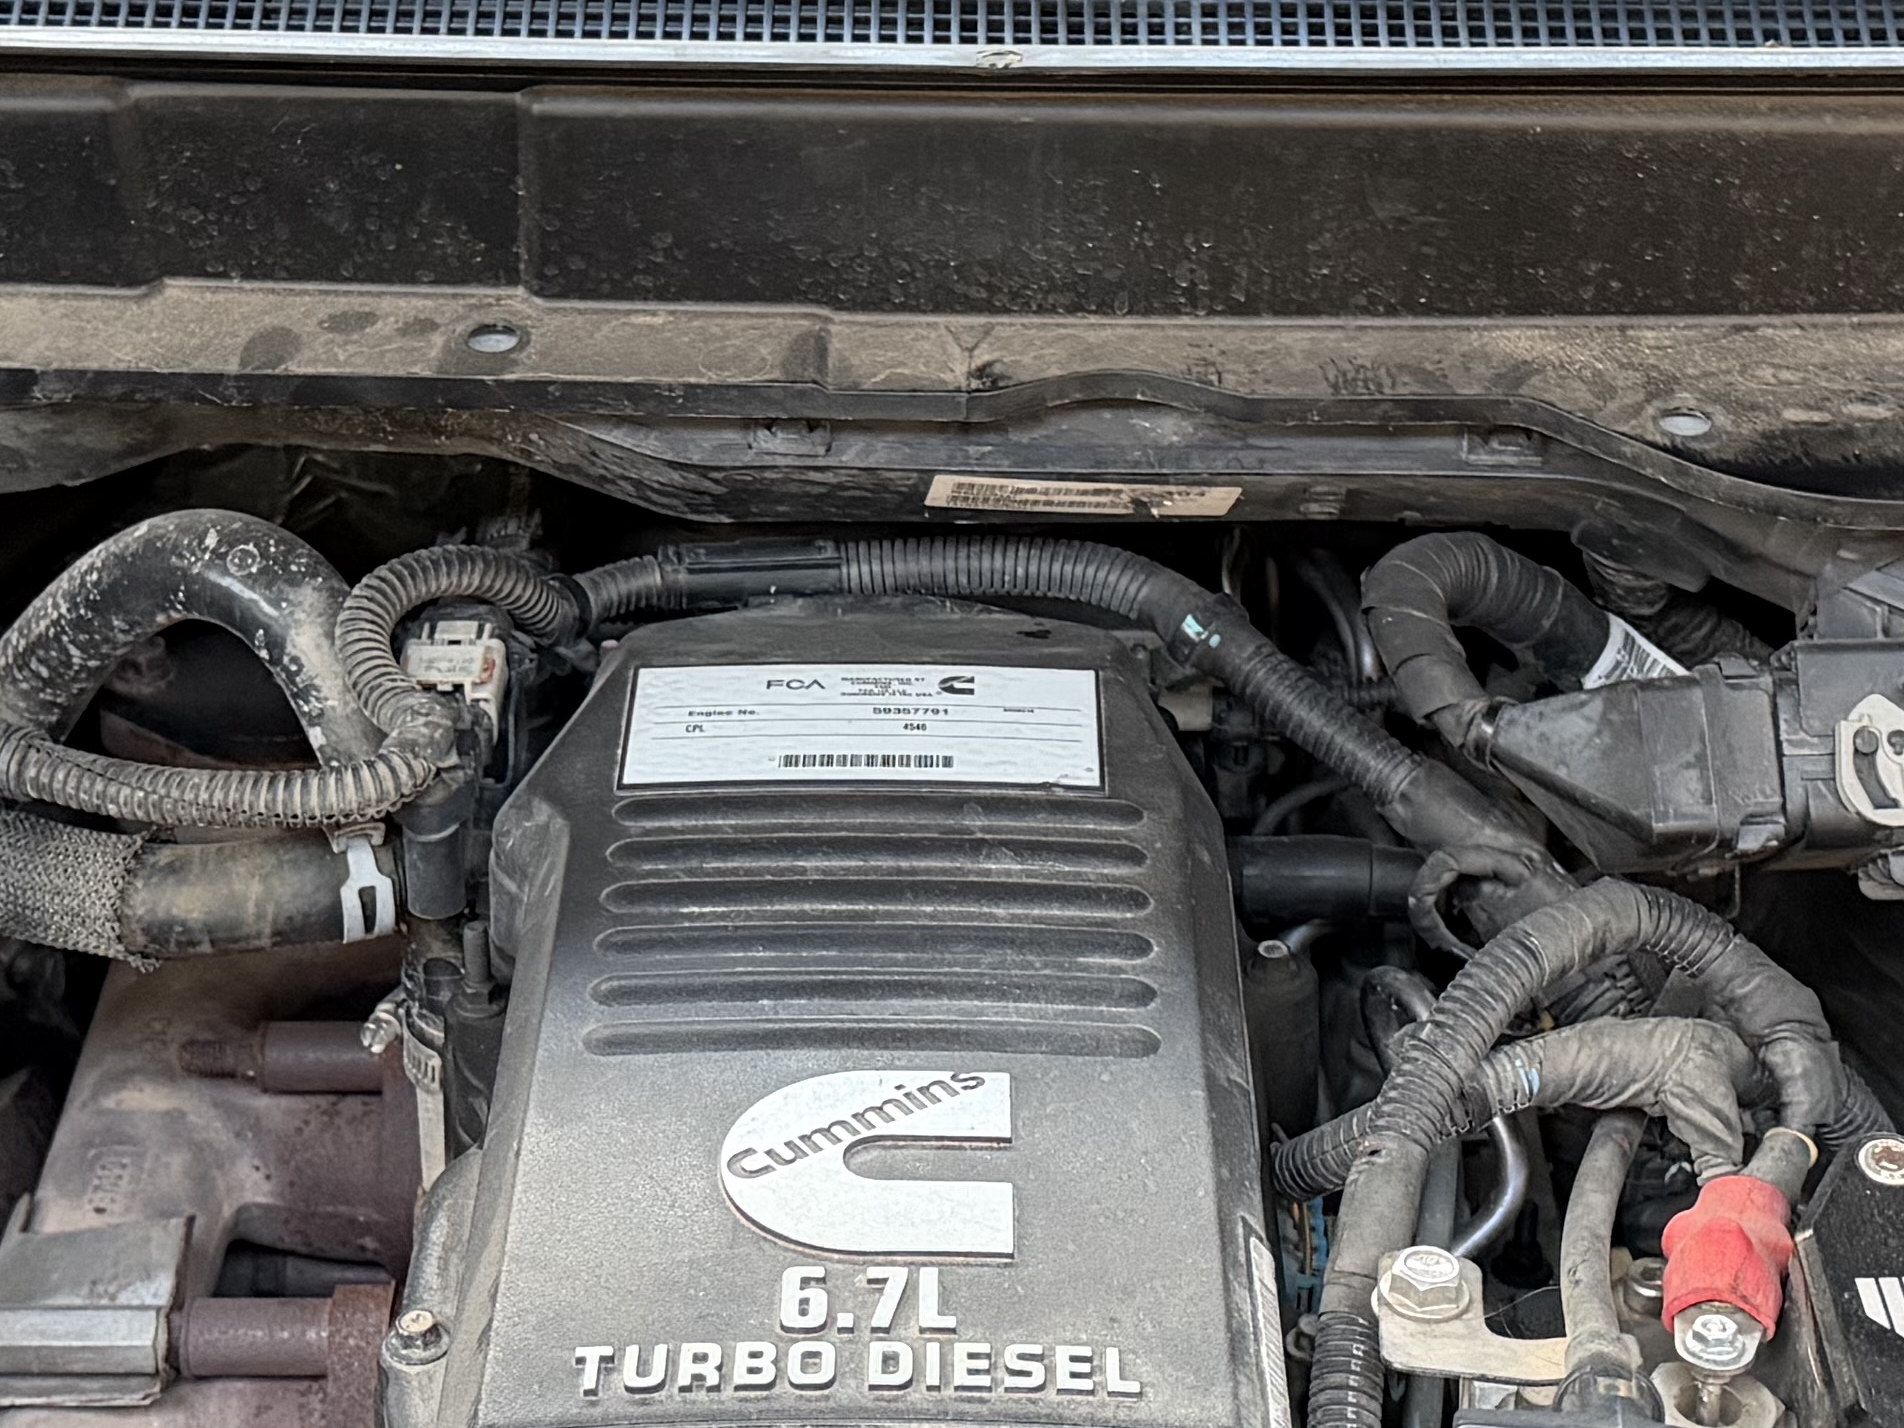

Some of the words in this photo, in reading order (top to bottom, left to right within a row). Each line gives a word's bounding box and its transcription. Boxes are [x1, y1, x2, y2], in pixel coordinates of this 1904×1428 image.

[766, 678, 826, 691] FCA
[684, 723, 706, 734] CPL
[687, 709, 733, 718] Engine
[724, 1065, 986, 1181] Cummins
[780, 1264, 957, 1336] 6.7L
[574, 1342, 838, 1400] TURBO
[865, 1340, 1144, 1399] DIESEL
